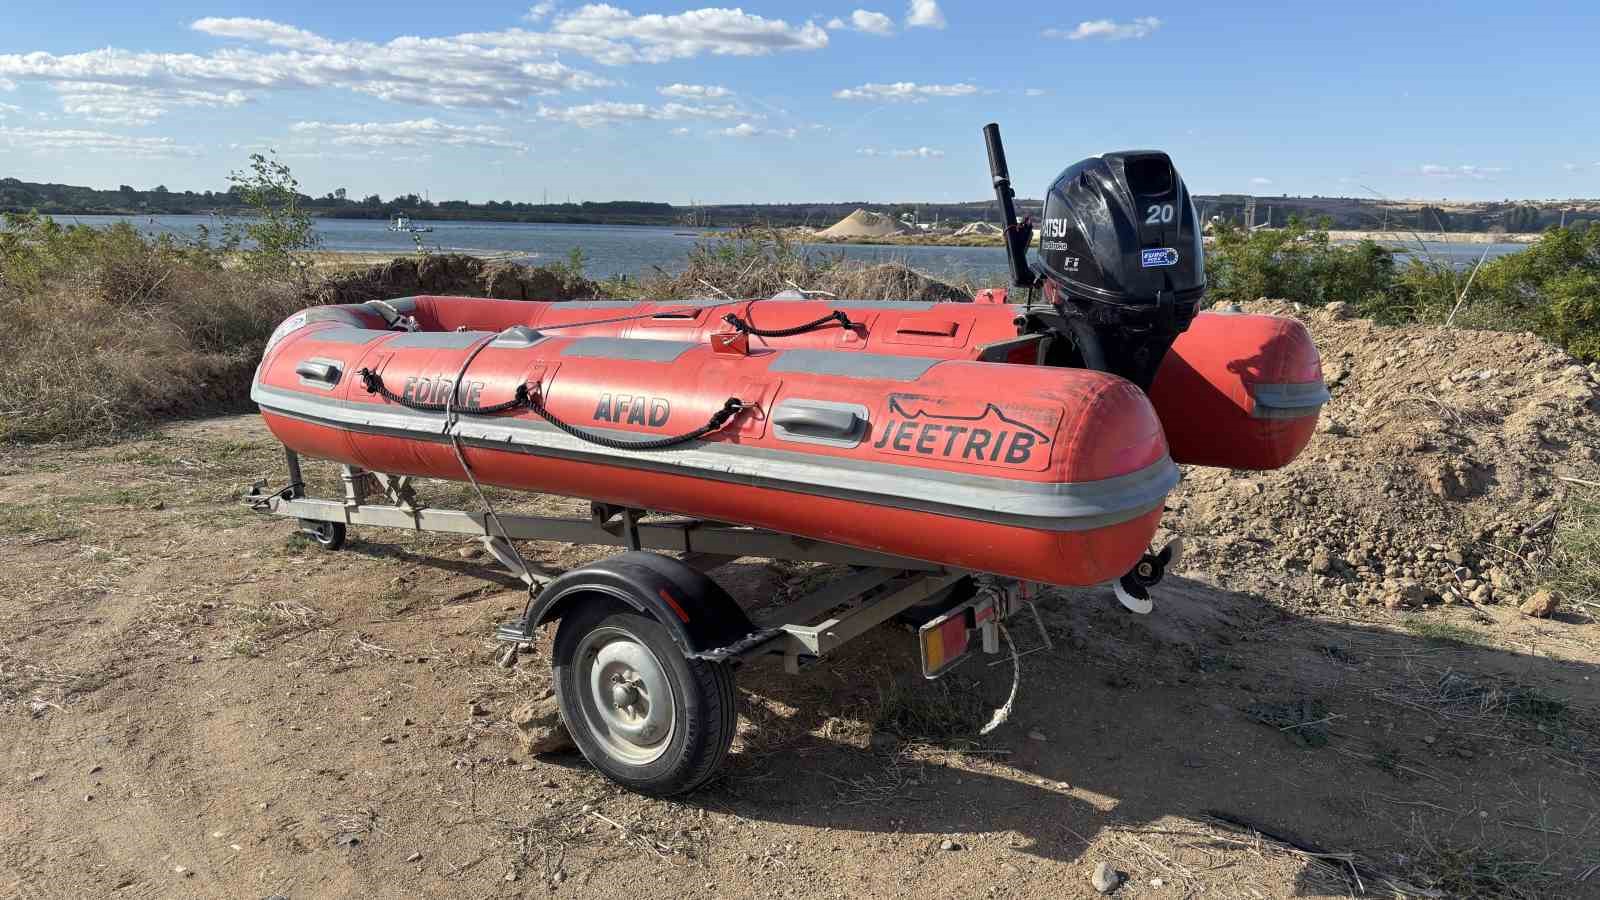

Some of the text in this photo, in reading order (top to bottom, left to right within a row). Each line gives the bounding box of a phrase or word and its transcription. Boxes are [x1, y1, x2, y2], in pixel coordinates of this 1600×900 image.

[1145, 204, 1174, 225] 20
[593, 392, 671, 427] AFAD
[873, 420, 1035, 465] JEETRIB
